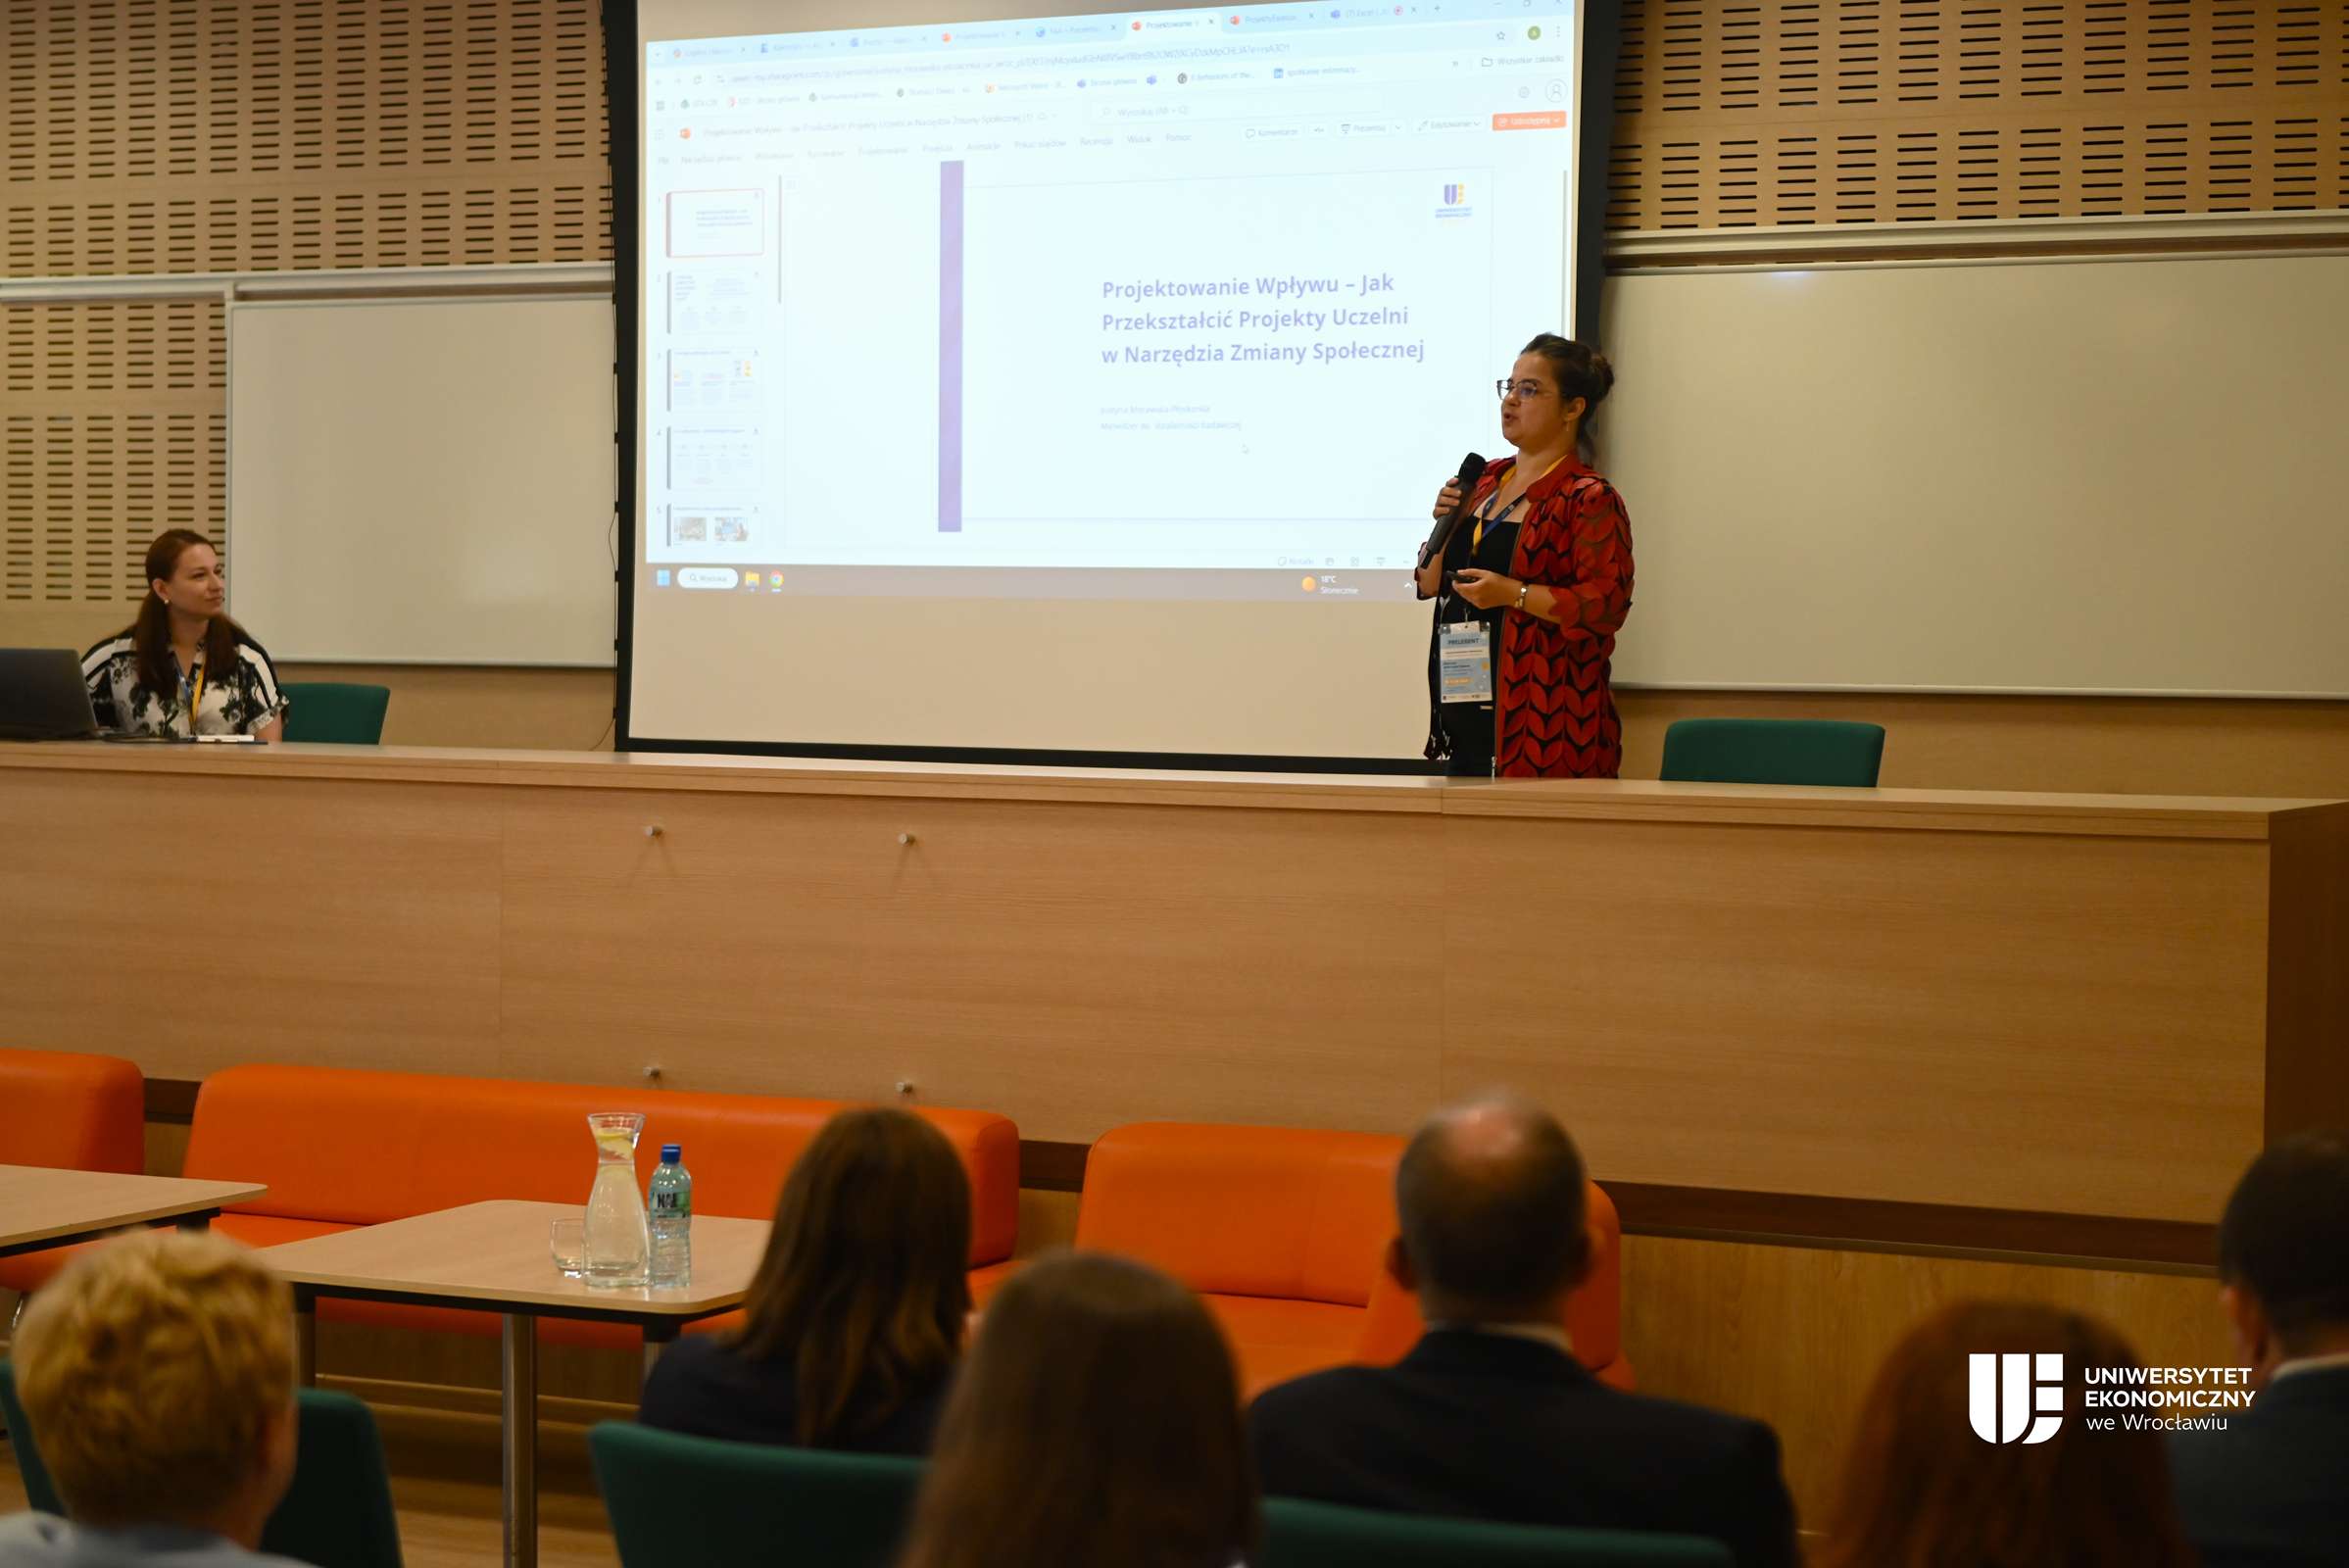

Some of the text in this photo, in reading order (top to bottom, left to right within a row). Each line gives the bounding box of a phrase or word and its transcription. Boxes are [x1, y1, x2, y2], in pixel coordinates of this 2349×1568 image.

[1102, 277, 1250, 303] Projektowanie
[1256, 275, 1340, 299] Wpływu
[1359, 272, 1395, 296] Jak
[1102, 306, 1409, 333] Przekształcić Projekty Uczelni
[1101, 339, 1425, 368] w Narzędzia Zmiany Społecznej
